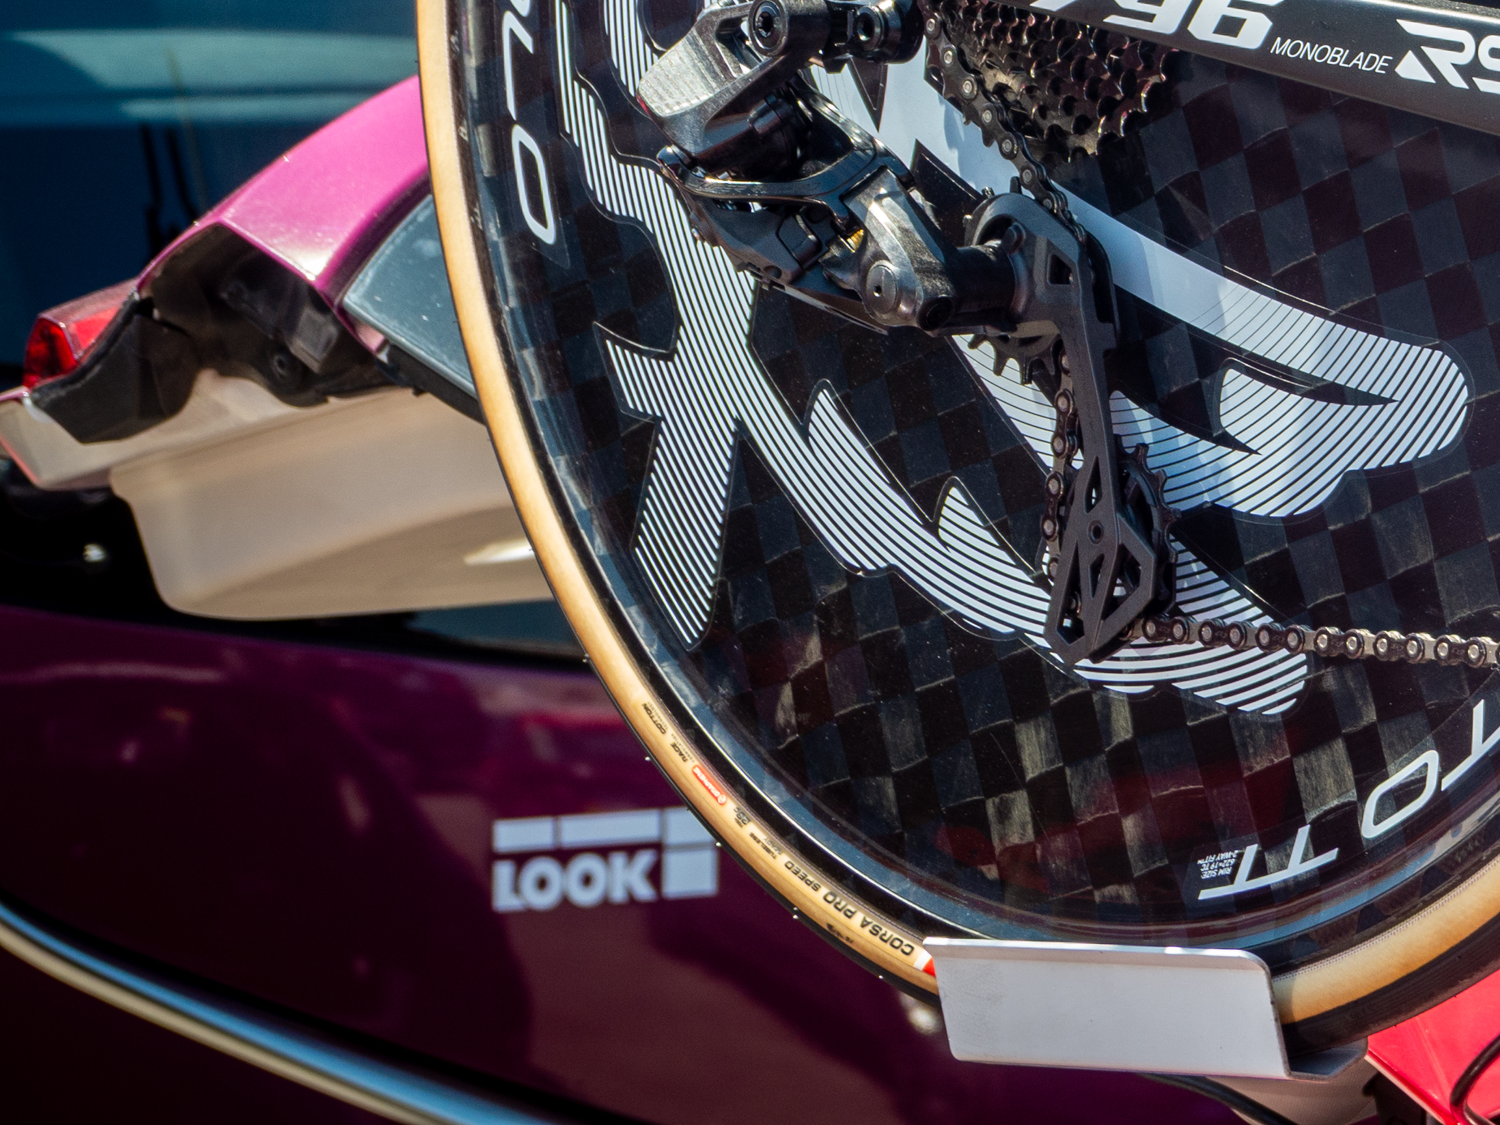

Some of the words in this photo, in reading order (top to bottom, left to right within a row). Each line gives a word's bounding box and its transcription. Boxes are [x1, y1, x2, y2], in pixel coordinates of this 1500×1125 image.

[1270, 36, 1393, 75] MONOBLADE
[641, 702, 667, 735] COTTON
[669, 741, 689, 763] RACE
[492, 848, 658, 912] LOOK
[784, 860, 822, 893] SPEED
[822, 891, 858, 920] PRO
[859, 914, 915, 957] CORSA
